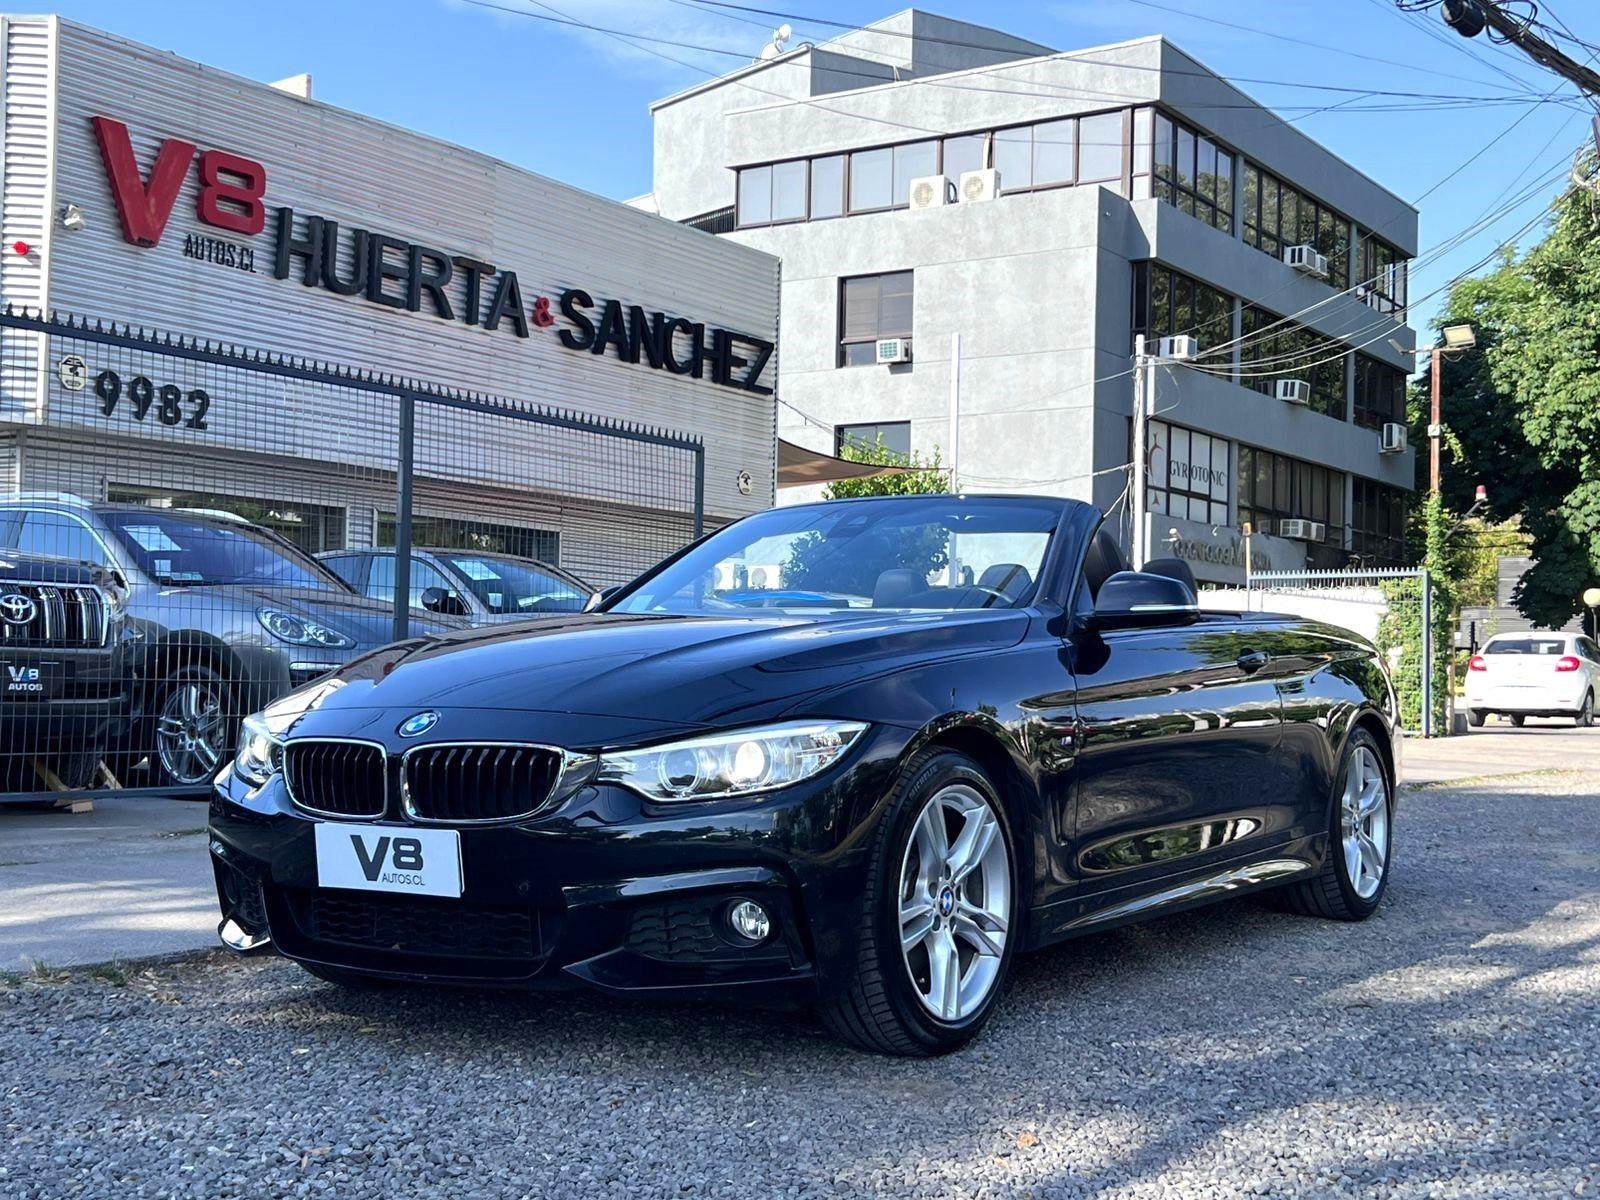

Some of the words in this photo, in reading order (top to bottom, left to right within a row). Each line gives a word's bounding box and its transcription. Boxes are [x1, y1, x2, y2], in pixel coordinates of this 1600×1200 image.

[91, 115, 266, 248] V8
[183, 233, 257, 274] AUTOS.CL
[274, 207, 529, 338] HUERTA
[532, 296, 555, 327] &
[559, 289, 774, 395] SANCHEZ
[97, 370, 210, 431] 9982
[8, 666, 39, 682] V8
[8, 682, 43, 691] AUTOS
[350, 834, 424, 882] V8
[381, 872, 426, 886] AUTOS.CL
